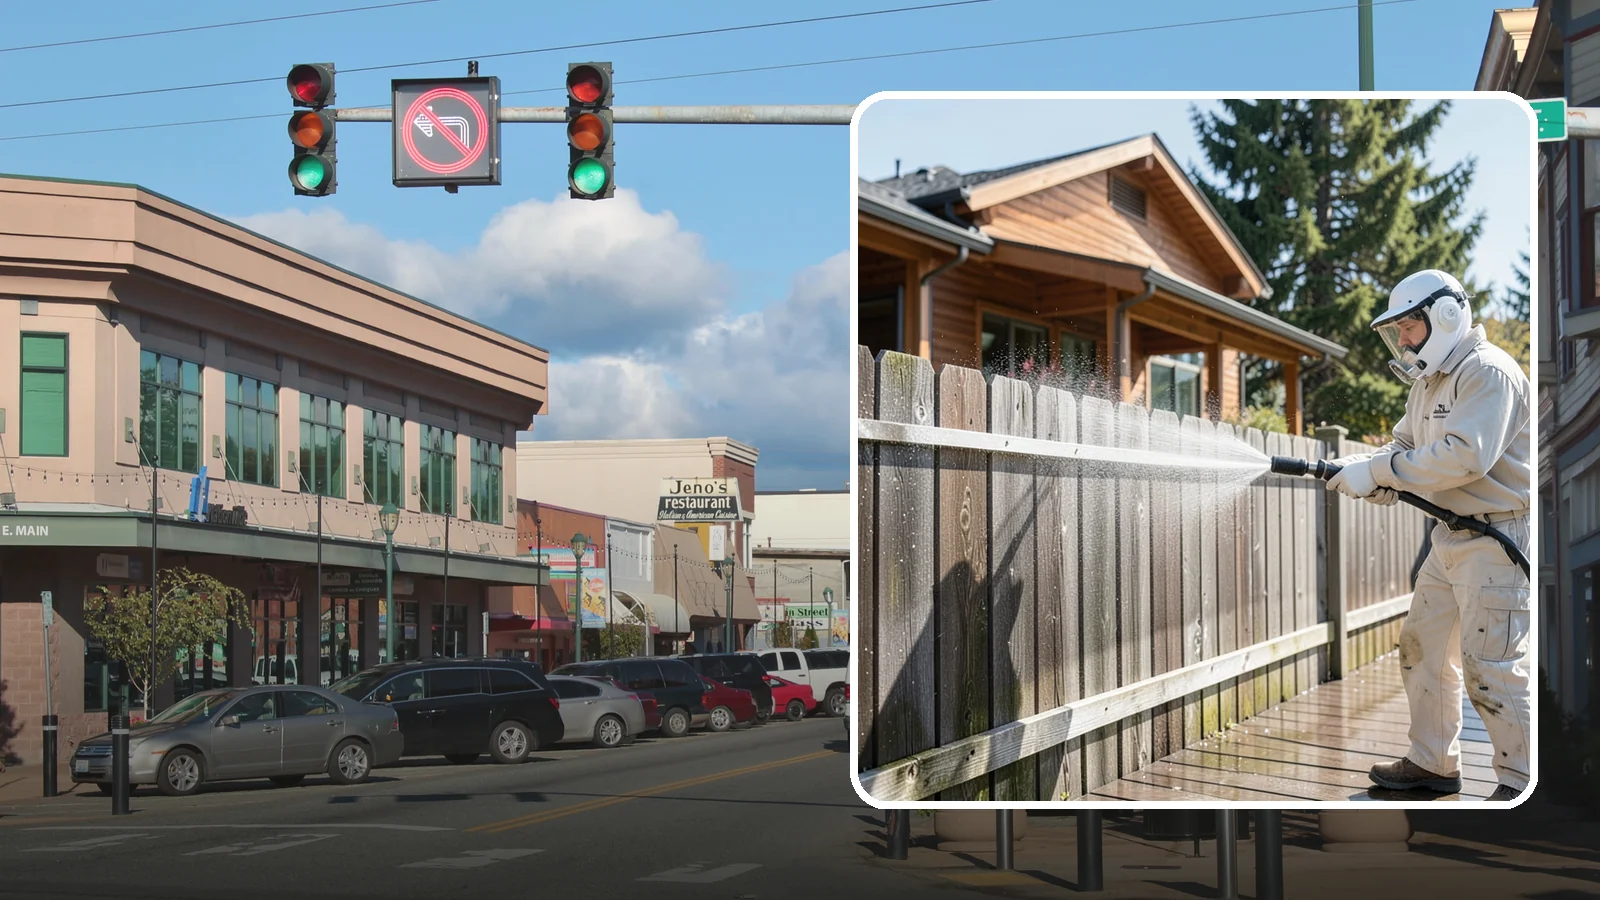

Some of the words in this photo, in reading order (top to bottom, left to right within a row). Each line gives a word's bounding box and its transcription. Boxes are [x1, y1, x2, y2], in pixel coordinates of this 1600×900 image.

[669, 480, 727, 494] Jeno's
[665, 496, 731, 509] restaurant
[658, 509, 682, 519] Italian
[685, 509, 714, 519] American
[714, 509, 738, 519] Cuisine
[2, 525, 13, 536] E.
[15, 525, 49, 536] MAIN
[797, 608, 829, 616] Street
